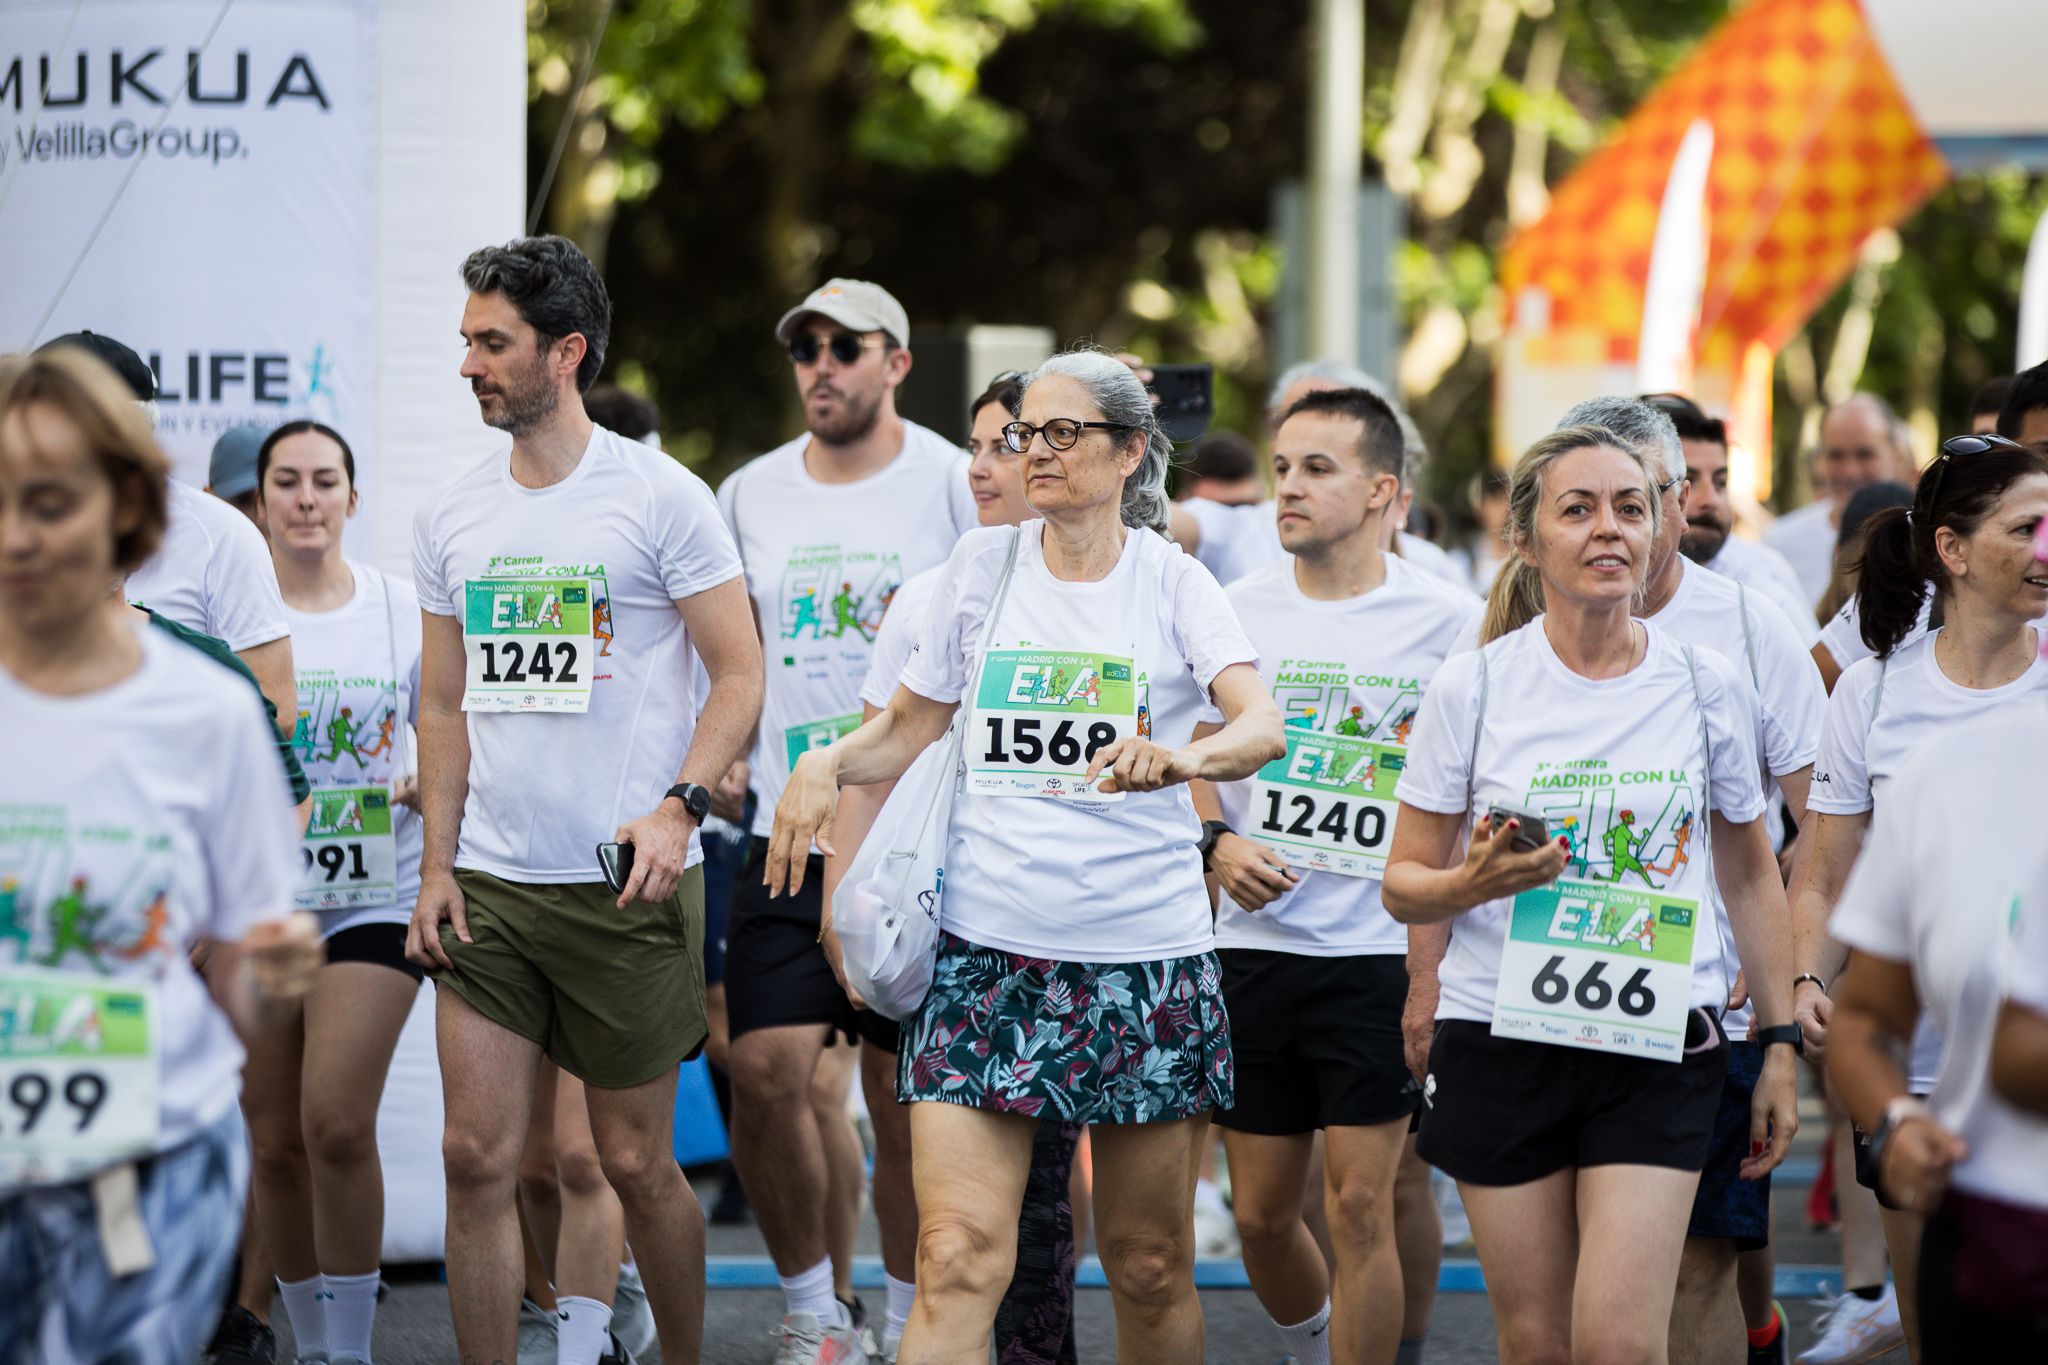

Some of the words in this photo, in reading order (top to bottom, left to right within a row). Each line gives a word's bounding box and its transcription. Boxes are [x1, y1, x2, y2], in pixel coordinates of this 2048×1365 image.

[149, 353, 289, 402] LIFE
[504, 555, 543, 566] Carrera
[545, 565, 579, 576] CON
[583, 564, 606, 576] LA
[494, 584, 524, 592] MADRID
[525, 584, 543, 592] CON
[544, 584, 555, 592] LA
[491, 593, 562, 629] ELA
[480, 641, 578, 683] 1242
[1018, 655, 1055, 664] MADRID
[1056, 656, 1078, 665] CON
[1079, 657, 1093, 665] LA
[1297, 660, 1346, 670] Carrera
[1006, 665, 1100, 707] ELA
[1276, 672, 1349, 685] MADRID
[1353, 674, 1393, 688] CON
[1398, 677, 1418, 689] LA
[984, 717, 1117, 769] 1568
[1300, 735, 1338, 749] MADRID
[1338, 741, 1360, 752] CON
[1286, 743, 1376, 793] ELA
[1554, 759, 1608, 771] Carrera
[1529, 773, 1614, 790] MADRID
[1618, 770, 1663, 786] CON
[1669, 768, 1689, 784] LA
[1262, 789, 1387, 848] 1240
[1561, 885, 1608, 900] MADRID
[1608, 892, 1635, 905] CON
[1636, 896, 1651, 907] LA
[1547, 897, 1655, 953] ELA
[1531, 955, 1657, 1017] 666
